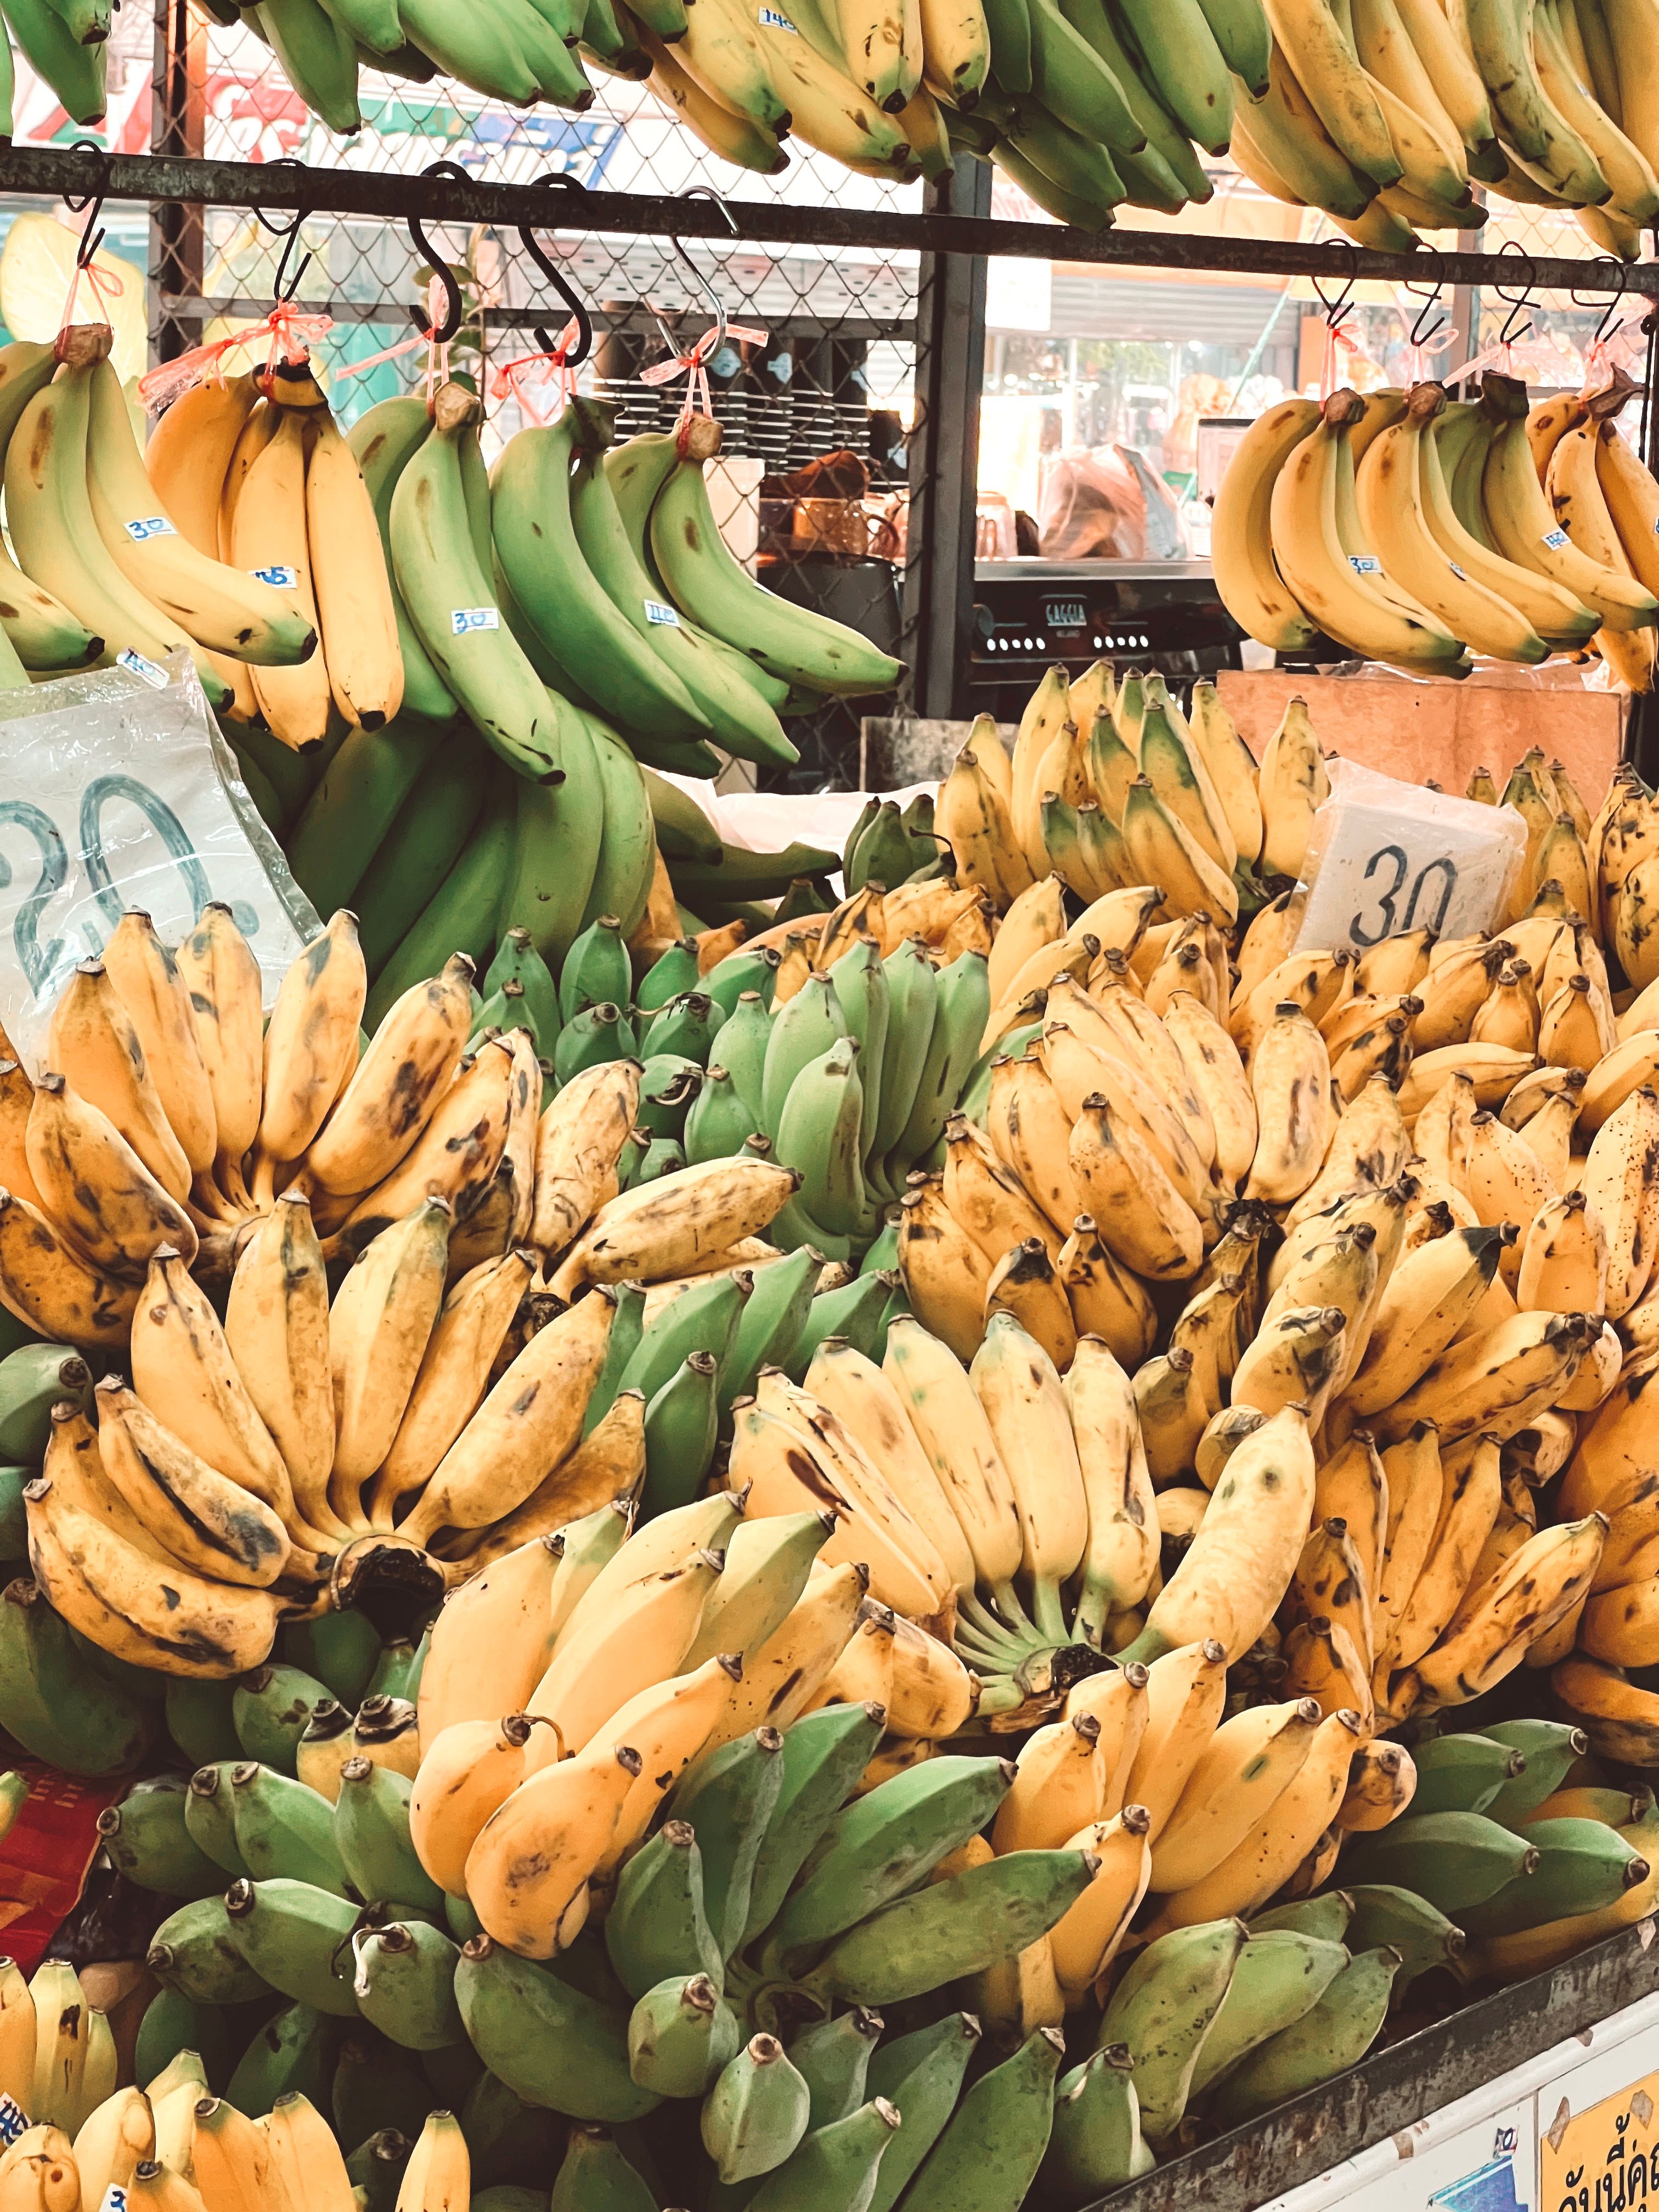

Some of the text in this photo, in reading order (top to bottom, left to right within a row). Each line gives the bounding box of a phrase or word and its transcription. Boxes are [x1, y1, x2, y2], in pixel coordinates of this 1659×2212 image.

[128, 518, 163, 538] 30
[1350, 557, 1374, 574] 30
[455, 612, 486, 634] 30
[1349, 844, 1458, 947] 30
